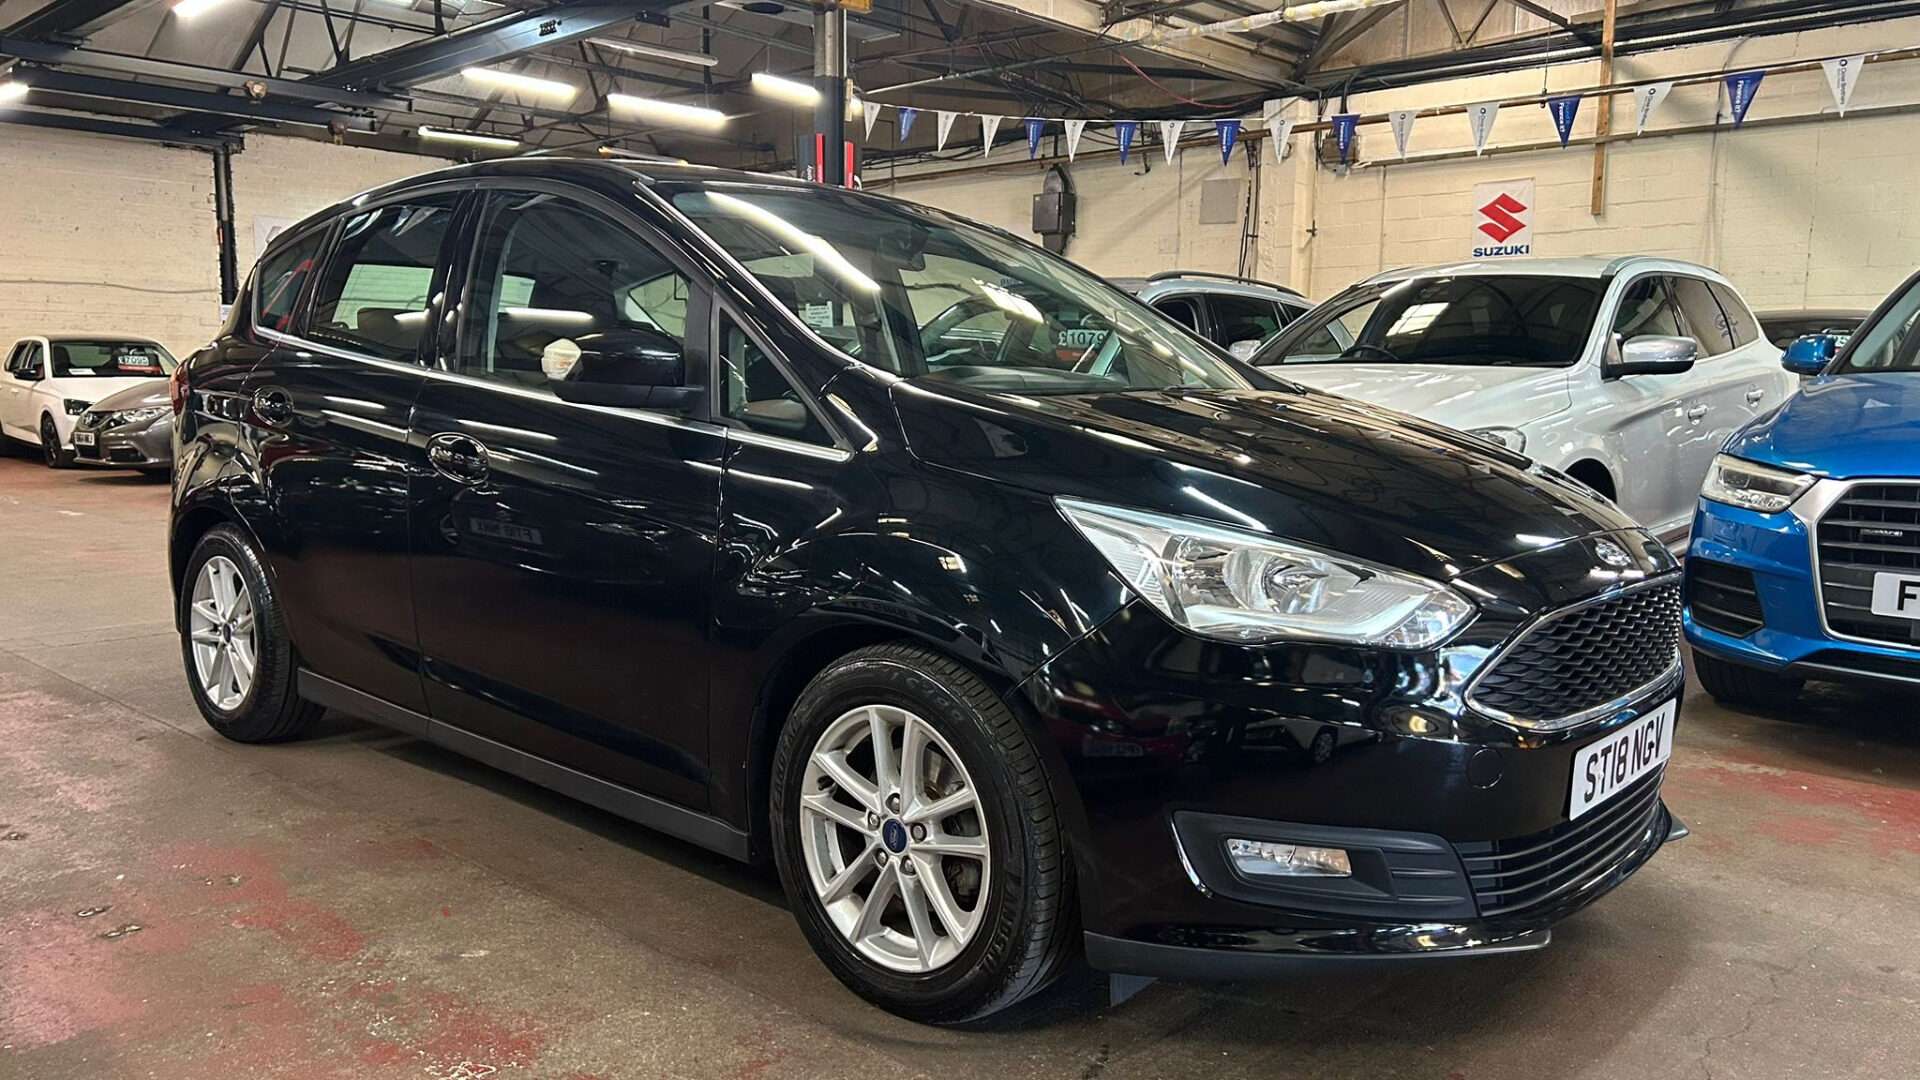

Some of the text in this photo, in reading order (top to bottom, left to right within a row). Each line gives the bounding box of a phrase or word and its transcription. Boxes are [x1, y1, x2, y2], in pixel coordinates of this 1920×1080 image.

[1472, 244, 1530, 257] SUZUKI
[1584, 711, 1666, 803] ST18 NGV
